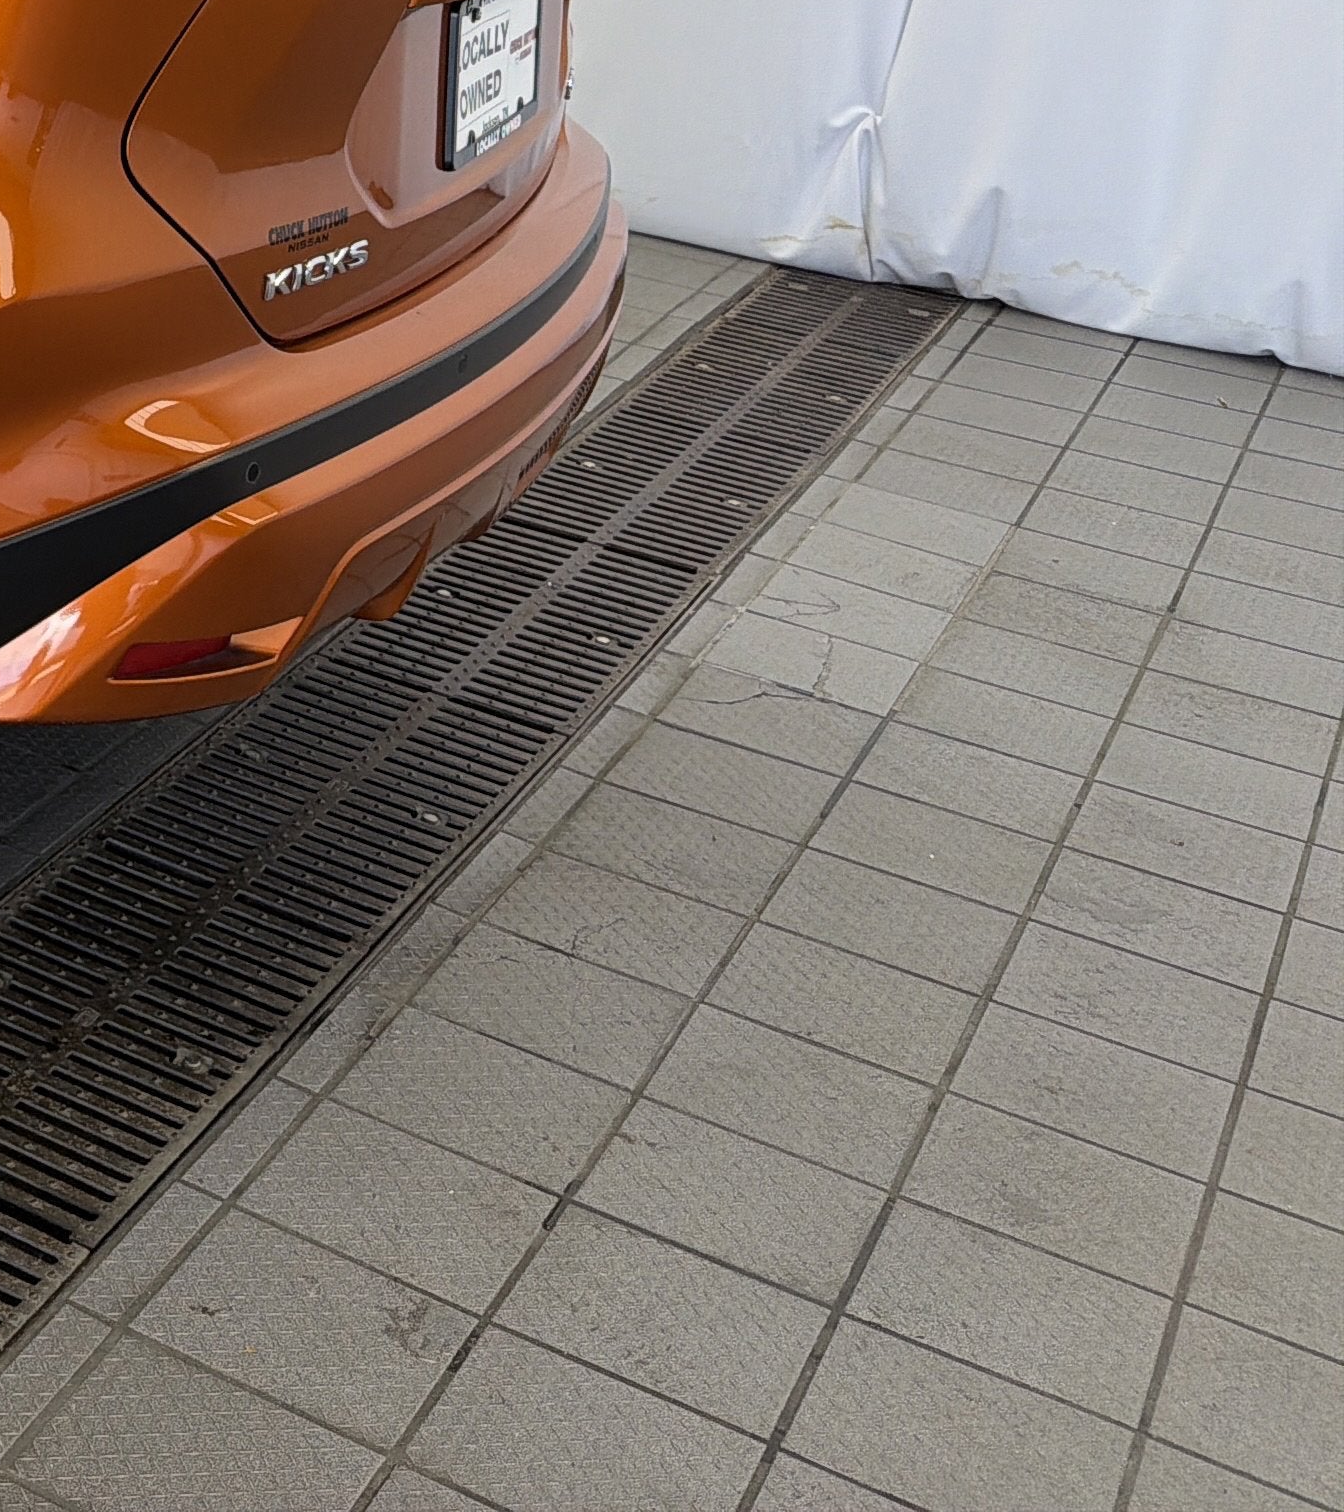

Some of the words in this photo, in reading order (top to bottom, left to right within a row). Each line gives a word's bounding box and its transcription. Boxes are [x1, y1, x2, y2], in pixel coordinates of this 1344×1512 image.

[460, 69, 502, 120] OWNED
[268, 220, 305, 246] CHUCK
[308, 207, 349, 234] HUTTON
[287, 233, 330, 253] NISSAN
[263, 239, 369, 302] KICKS
